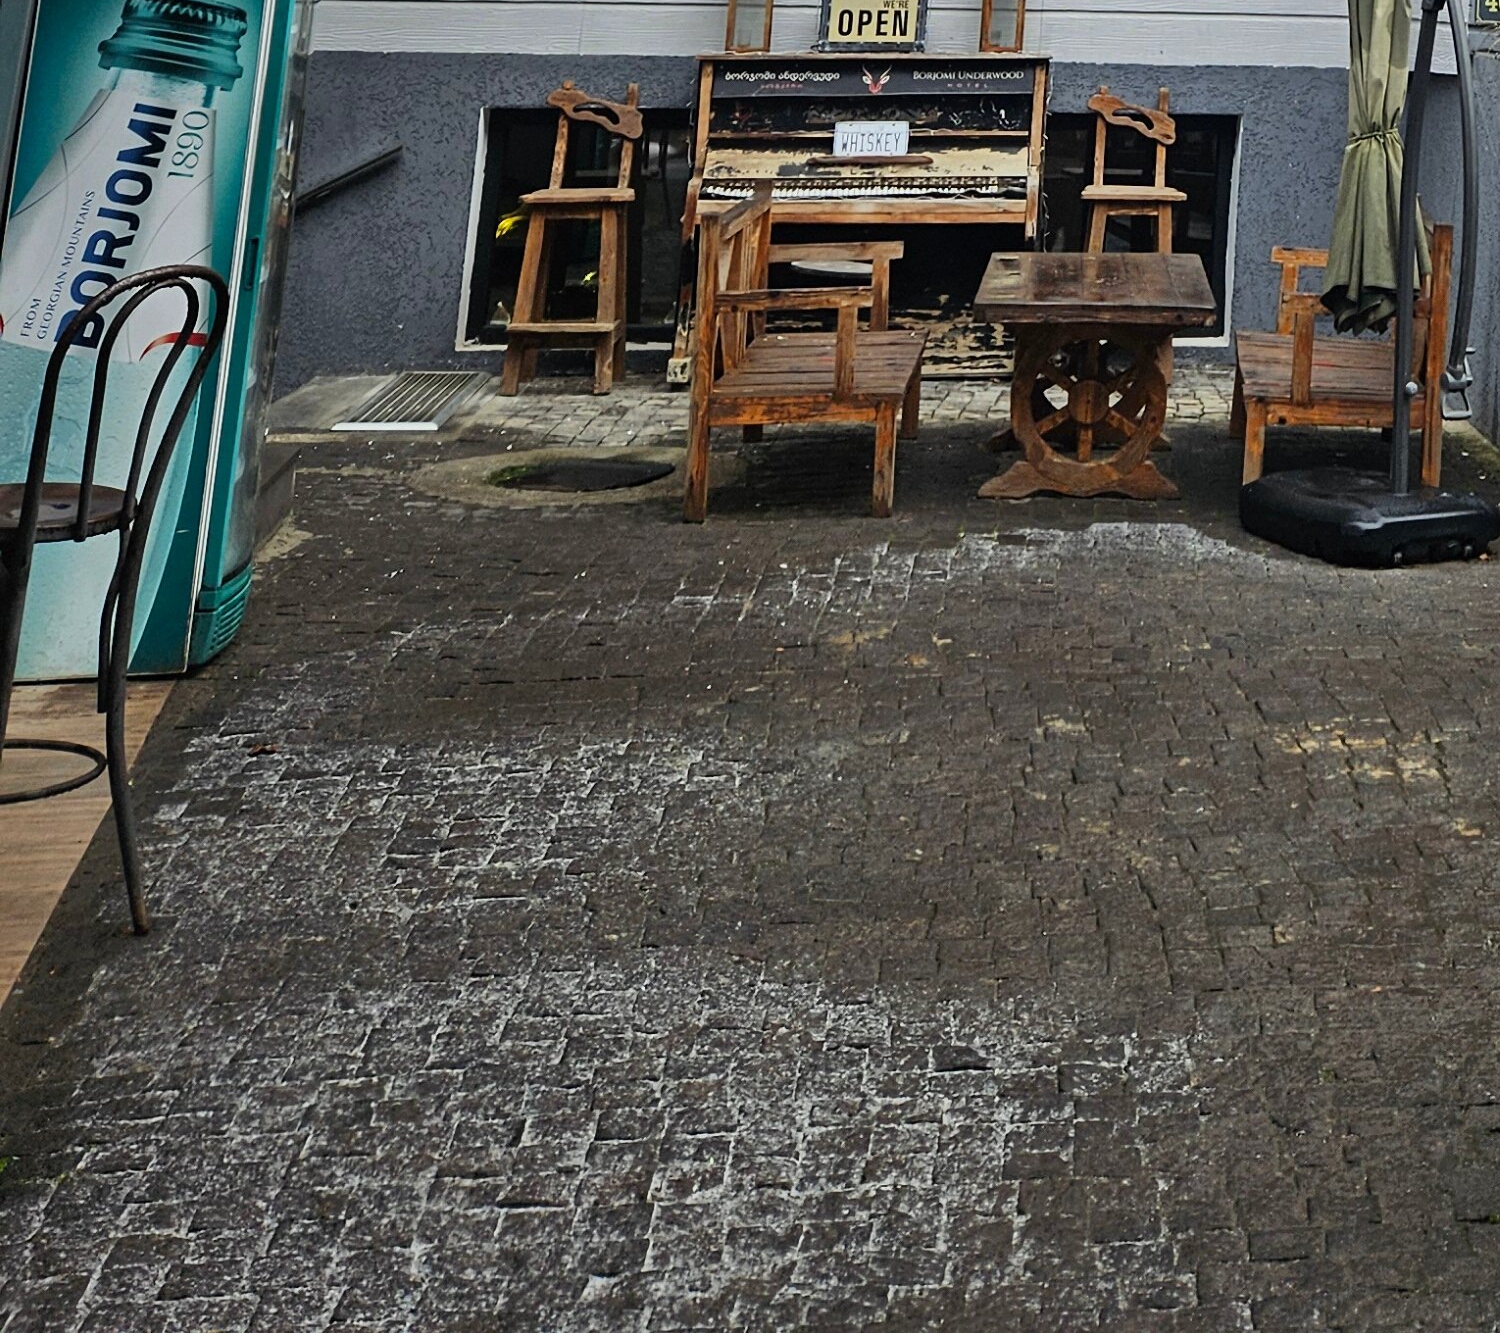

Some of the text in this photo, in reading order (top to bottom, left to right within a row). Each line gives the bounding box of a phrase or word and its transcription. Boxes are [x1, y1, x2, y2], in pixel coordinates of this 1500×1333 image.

[883, 0, 910, 9] WE'RE
[838, 9, 909, 36] OPEN
[913, 71, 1024, 80] BORJOMI UNDERWOOD
[168, 110, 209, 178] 1890
[841, 132, 901, 152] WHISKEY
[54, 103, 177, 349] BORJOMI
[37, 190, 95, 340] GEORGIAN MOUNTAINS
[20, 298, 42, 337] FROM
